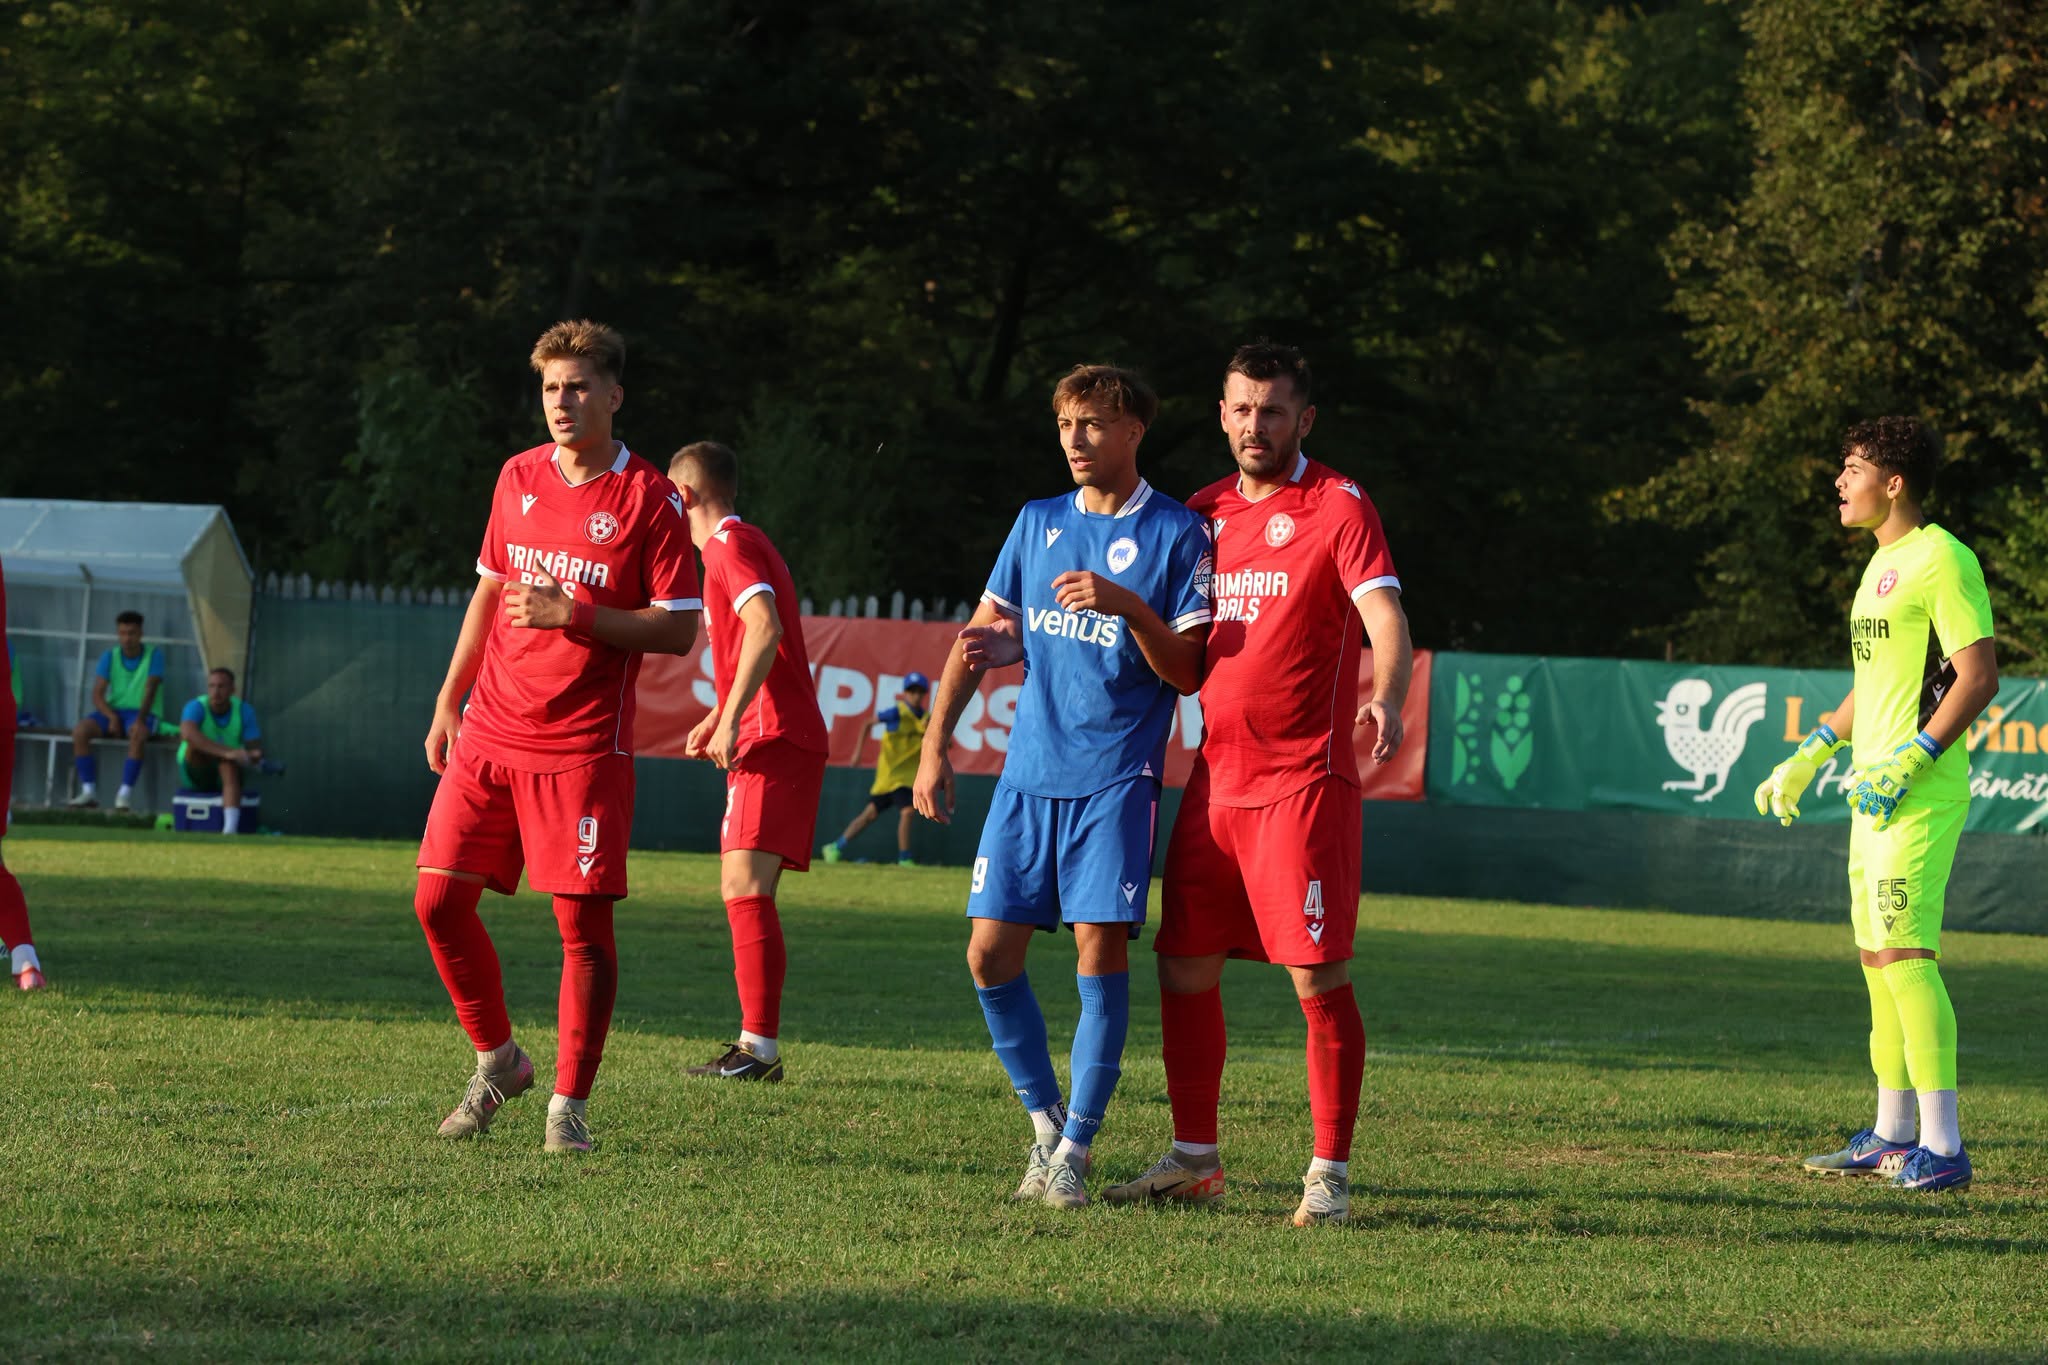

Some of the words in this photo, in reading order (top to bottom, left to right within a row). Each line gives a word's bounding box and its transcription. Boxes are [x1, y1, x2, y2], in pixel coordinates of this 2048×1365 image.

[506, 543, 609, 588] PRIMĂRIA
[1210, 568, 1289, 598] RIMĂRIA
[520, 571, 576, 600] BAS
[1027, 607, 1119, 648] venus
[578, 816, 598, 854] 9
[1303, 880, 1325, 920] 4
[1877, 878, 1908, 911] 55
